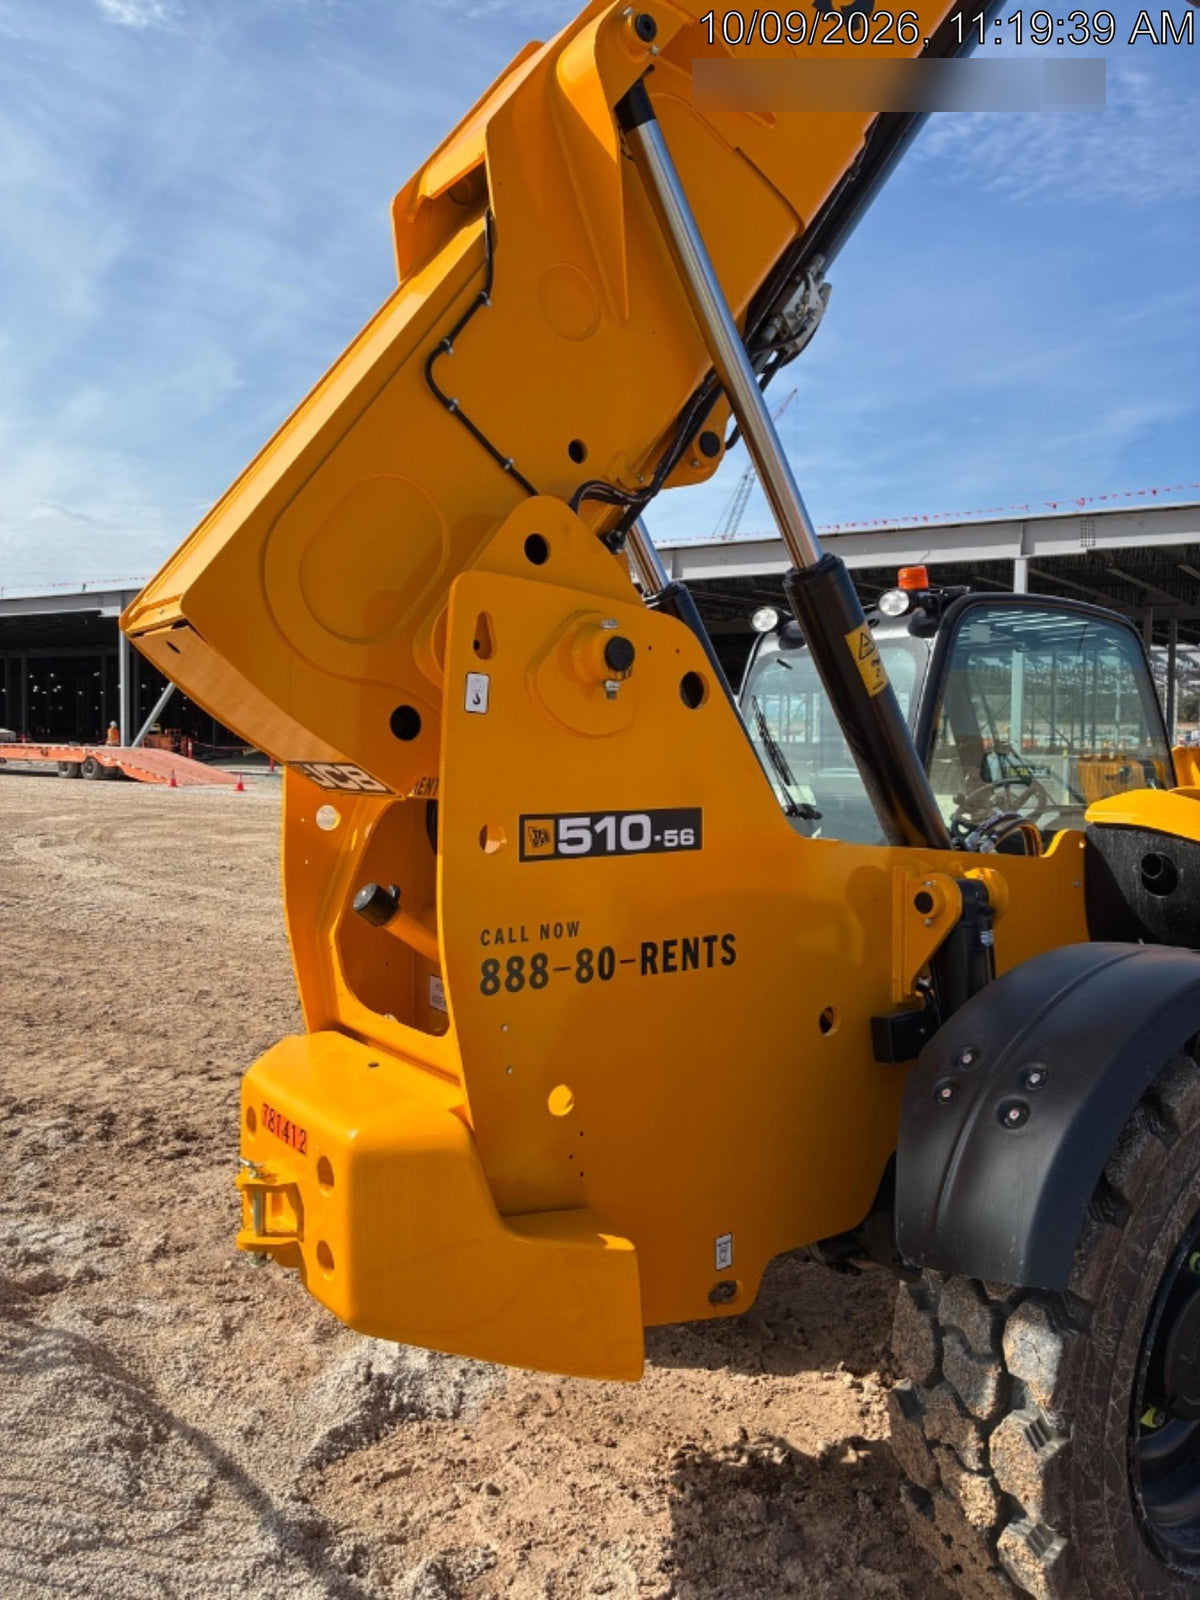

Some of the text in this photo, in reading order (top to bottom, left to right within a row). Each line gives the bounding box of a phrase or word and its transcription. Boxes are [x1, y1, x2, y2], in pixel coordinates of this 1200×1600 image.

[480, 920, 580, 947] CALL NOW
[479, 933, 738, 997] 888-80-RENTS
